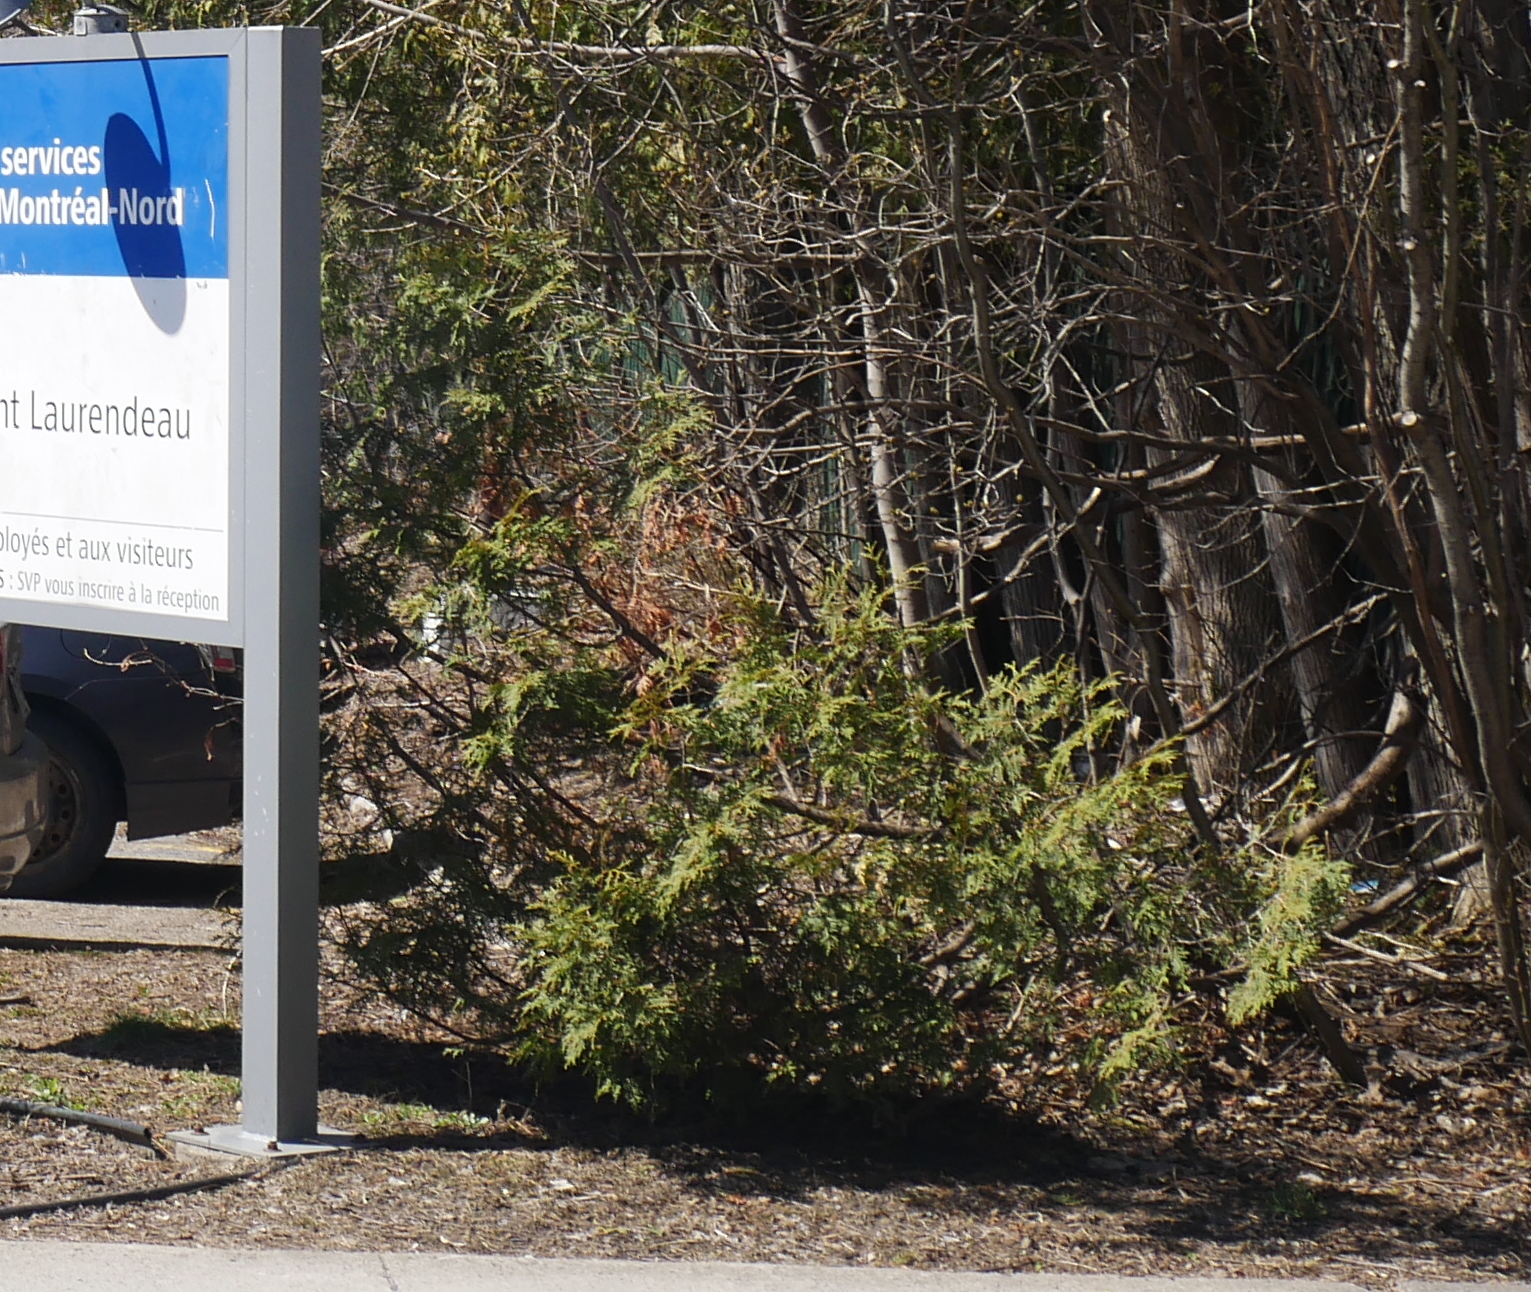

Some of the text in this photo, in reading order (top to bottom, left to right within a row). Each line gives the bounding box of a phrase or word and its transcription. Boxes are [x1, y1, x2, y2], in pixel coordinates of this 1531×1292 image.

[1, 138, 100, 176] services
[31, 390, 190, 439] Laurendeau
[56, 532, 73, 558] et
[79, 538, 111, 562] aux
[117, 537, 193, 569] visiteurs
[17, 571, 41, 592] SVP
[45, 577, 74, 597] vous
[79, 578, 124, 602] inscrire
[129, 581, 136, 602] à
[141, 584, 152, 604] la
[157, 585, 219, 613] réception
